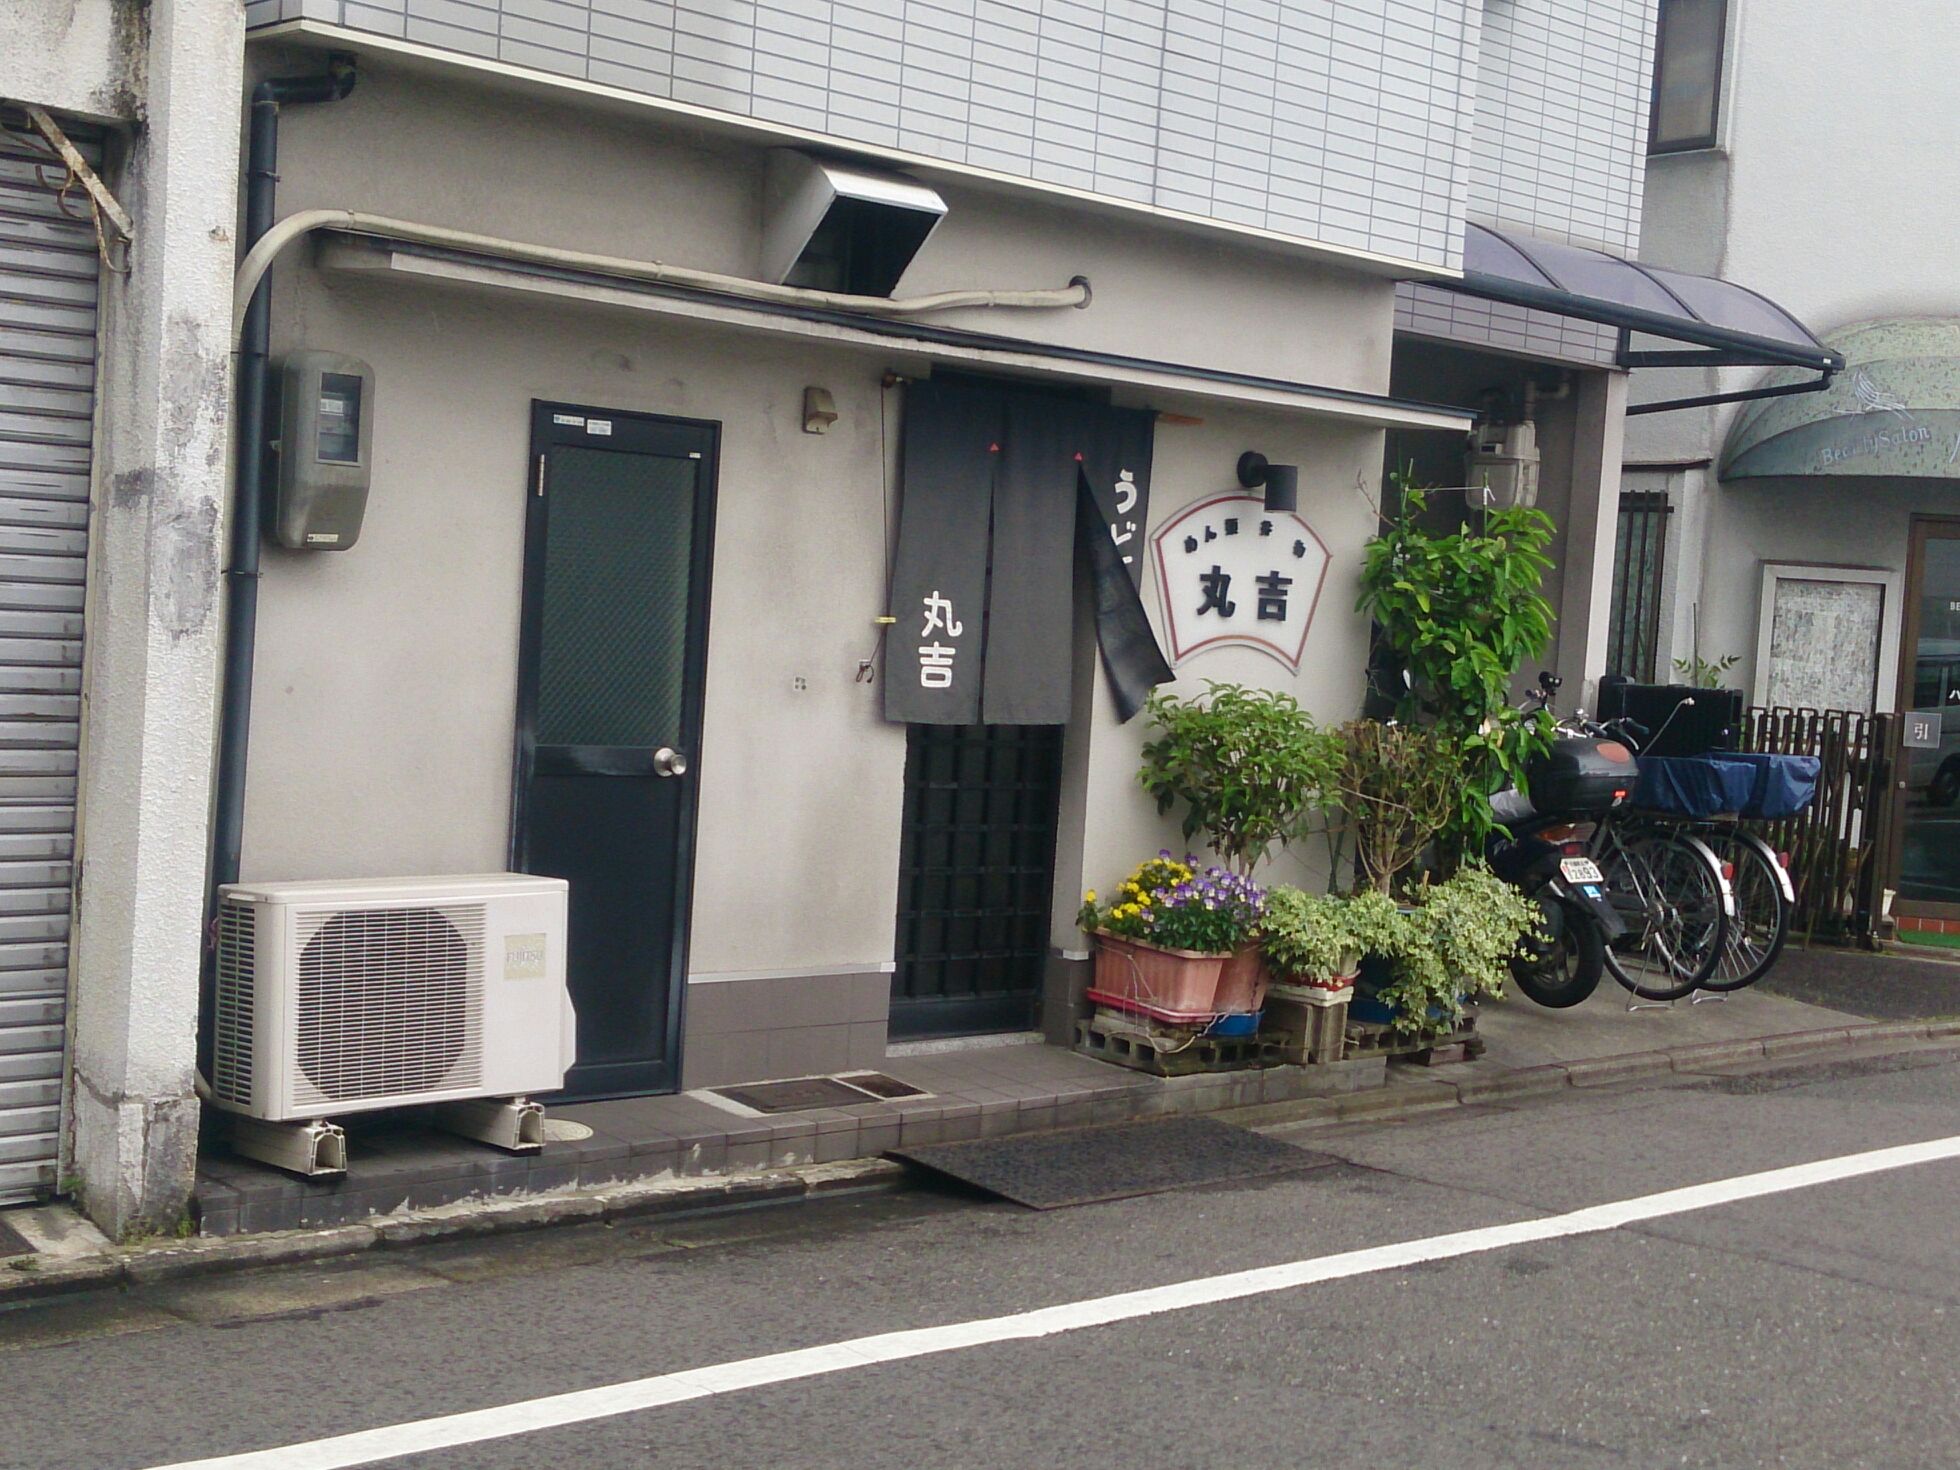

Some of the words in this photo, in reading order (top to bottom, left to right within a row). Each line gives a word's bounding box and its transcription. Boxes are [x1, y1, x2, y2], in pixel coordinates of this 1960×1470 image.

[1196, 564, 1293, 621] 丸吉
[918, 590, 963, 688] 丸吉
[1914, 722, 1929, 741] 引
